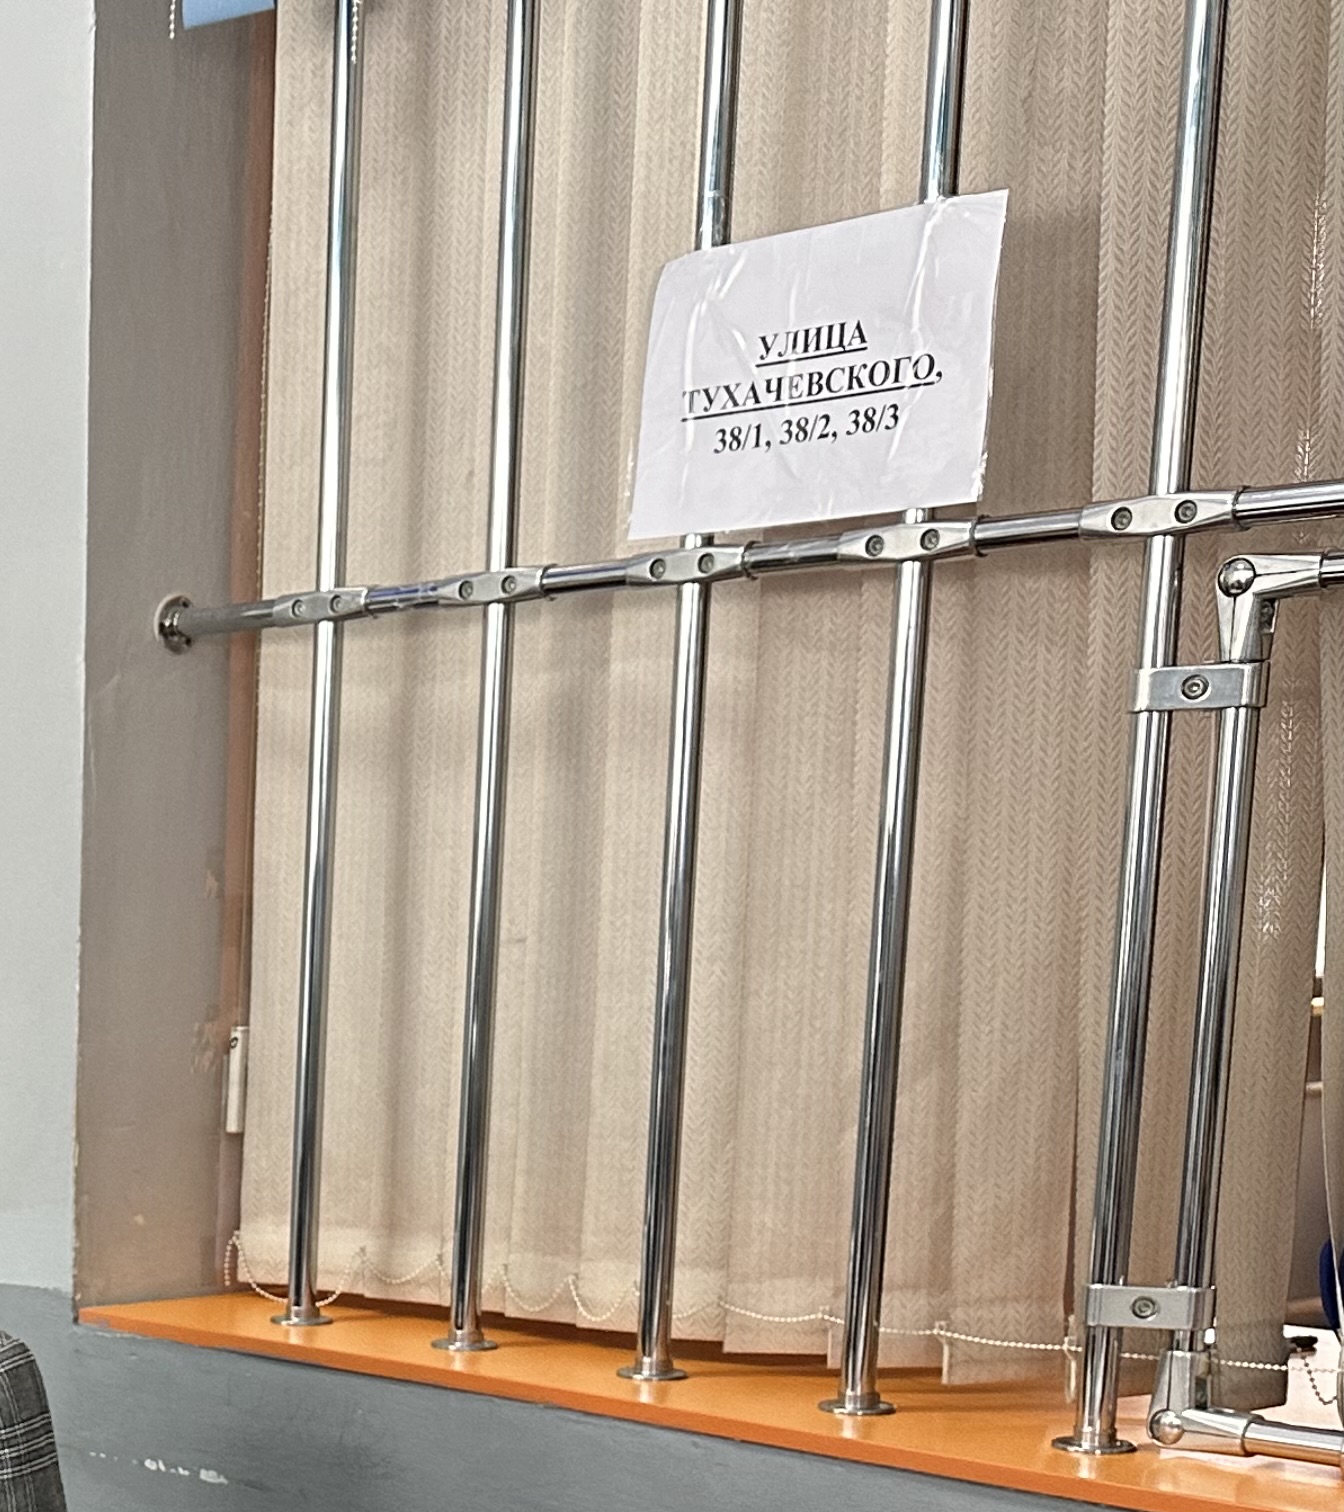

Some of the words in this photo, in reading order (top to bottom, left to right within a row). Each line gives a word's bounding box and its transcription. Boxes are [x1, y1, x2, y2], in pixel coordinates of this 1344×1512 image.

[757, 319, 868, 362] УЛИЦА
[681, 352, 943, 415] ТУХАЧЕВСКОГО,
[713, 426, 772, 455] 38/1,
[779, 413, 839, 446] 38/2,
[845, 403, 901, 437] 38/3
